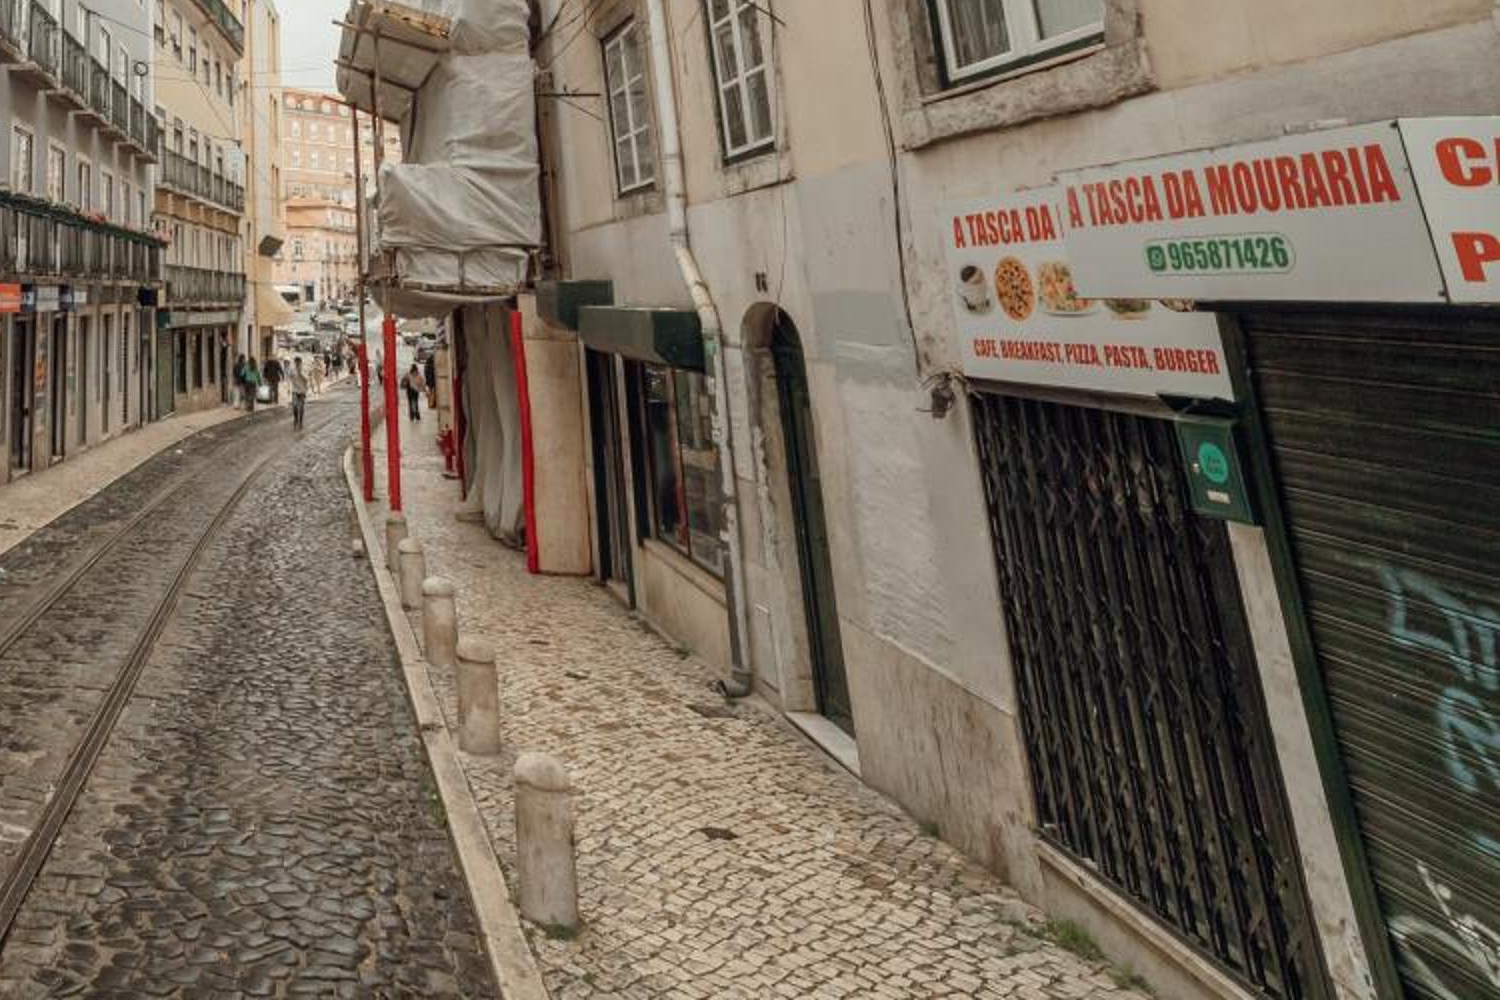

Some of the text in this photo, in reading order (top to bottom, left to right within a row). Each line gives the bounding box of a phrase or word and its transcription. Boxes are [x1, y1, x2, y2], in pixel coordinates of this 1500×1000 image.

[1436, 137, 1500, 187] C
[1066, 186, 1084, 229] A
[1083, 174, 1164, 229] TASCA
[1162, 168, 1206, 220] DA
[1204, 143, 1401, 217] MOURARIA
[953, 216, 966, 249] A
[966, 209, 1025, 246] TASCA
[1026, 204, 1057, 241] DA
[1169, 236, 1290, 272] 965871426
[1153, 347, 1221, 375] BURGER
